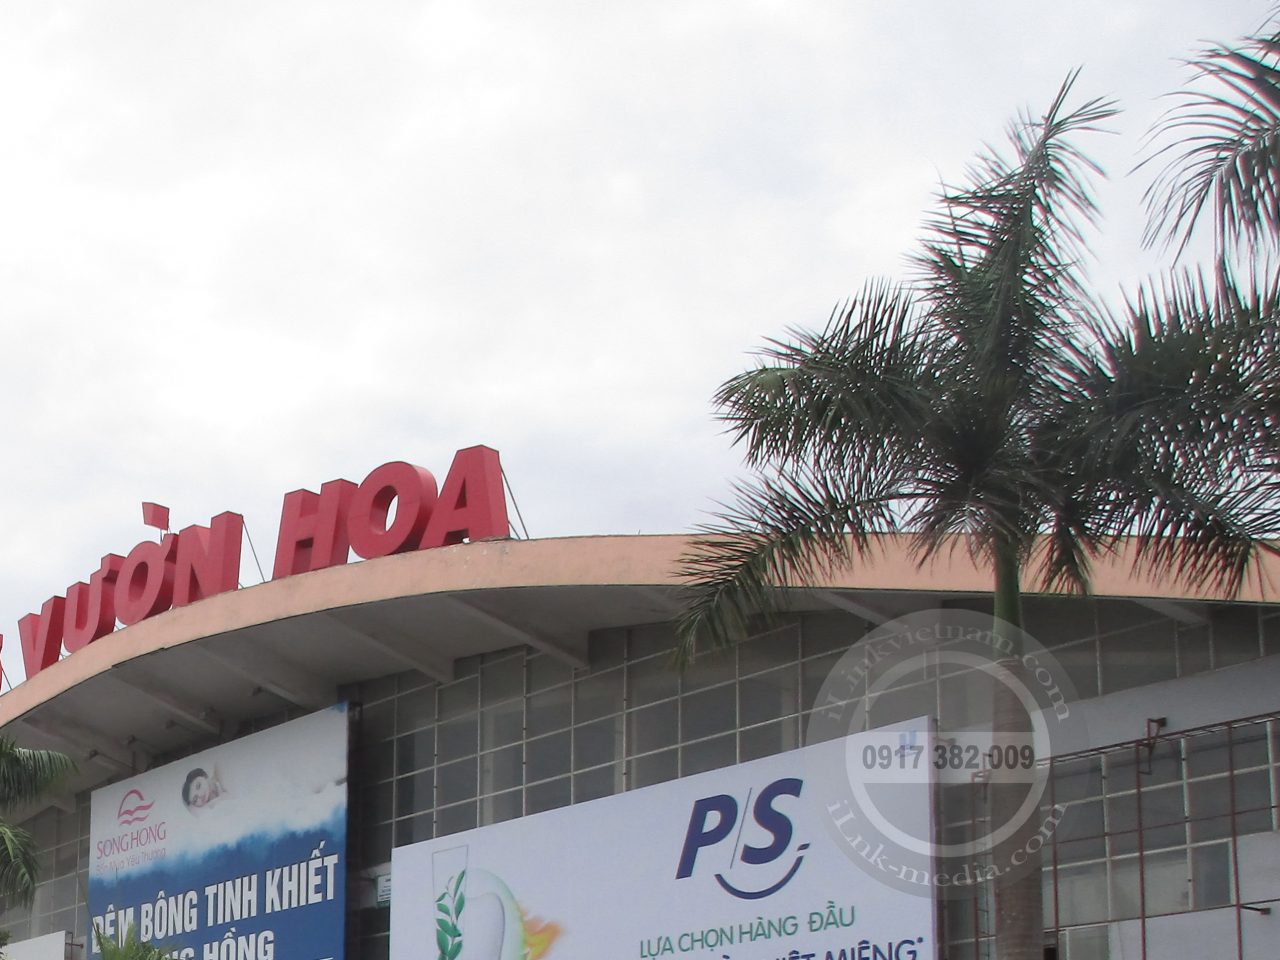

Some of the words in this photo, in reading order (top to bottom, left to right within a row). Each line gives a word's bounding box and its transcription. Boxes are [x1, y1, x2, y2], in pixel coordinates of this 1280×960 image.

[18, 502, 244, 680] VƯỜN
[272, 444, 510, 581] HOA
[140, 890, 198, 943] BÔNG
[204, 874, 258, 928] TINH
[265, 841, 339, 914] KHIẾT
[640, 936, 675, 960] LỰA
[678, 925, 734, 952] CHỌN
[738, 915, 799, 944] HÀNG
[808, 900, 856, 932] ĐẦU
